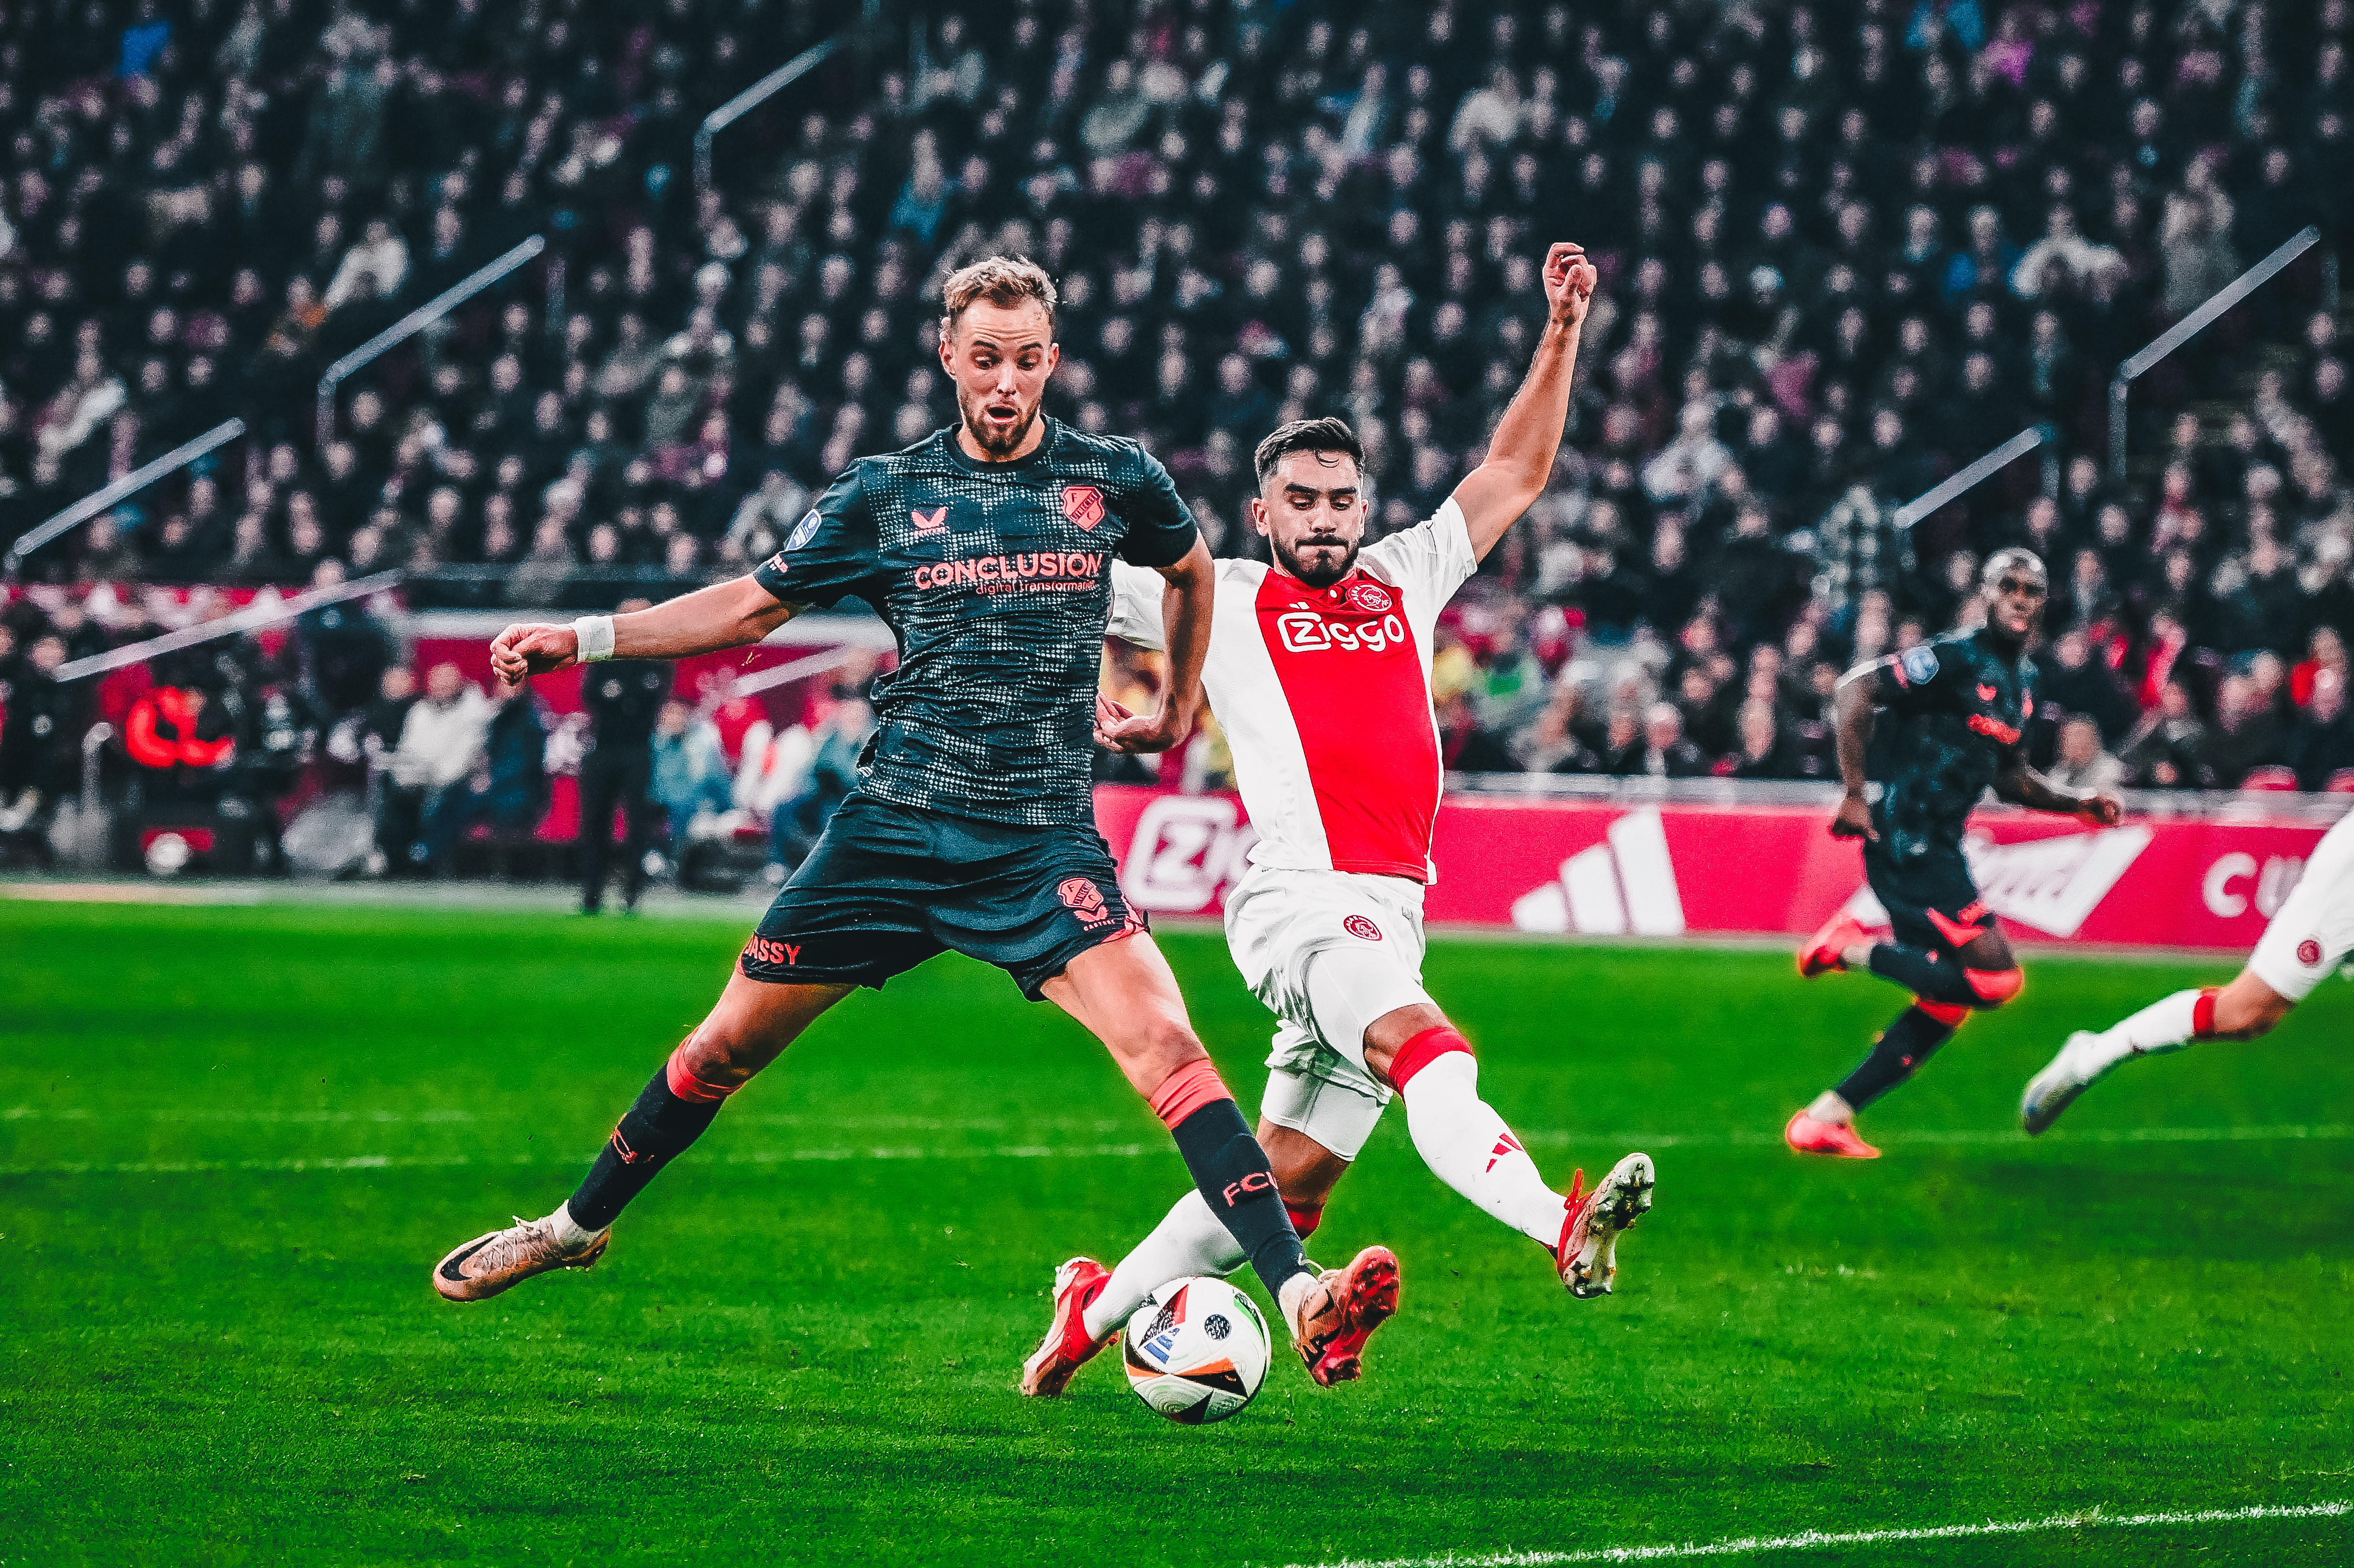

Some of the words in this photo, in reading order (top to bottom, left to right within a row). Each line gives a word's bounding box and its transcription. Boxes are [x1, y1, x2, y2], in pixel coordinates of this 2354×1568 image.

[915, 553, 1103, 590] CONCLUSION
[976, 581, 1015, 595] digital
[1277, 612, 1405, 652] Ziggo
